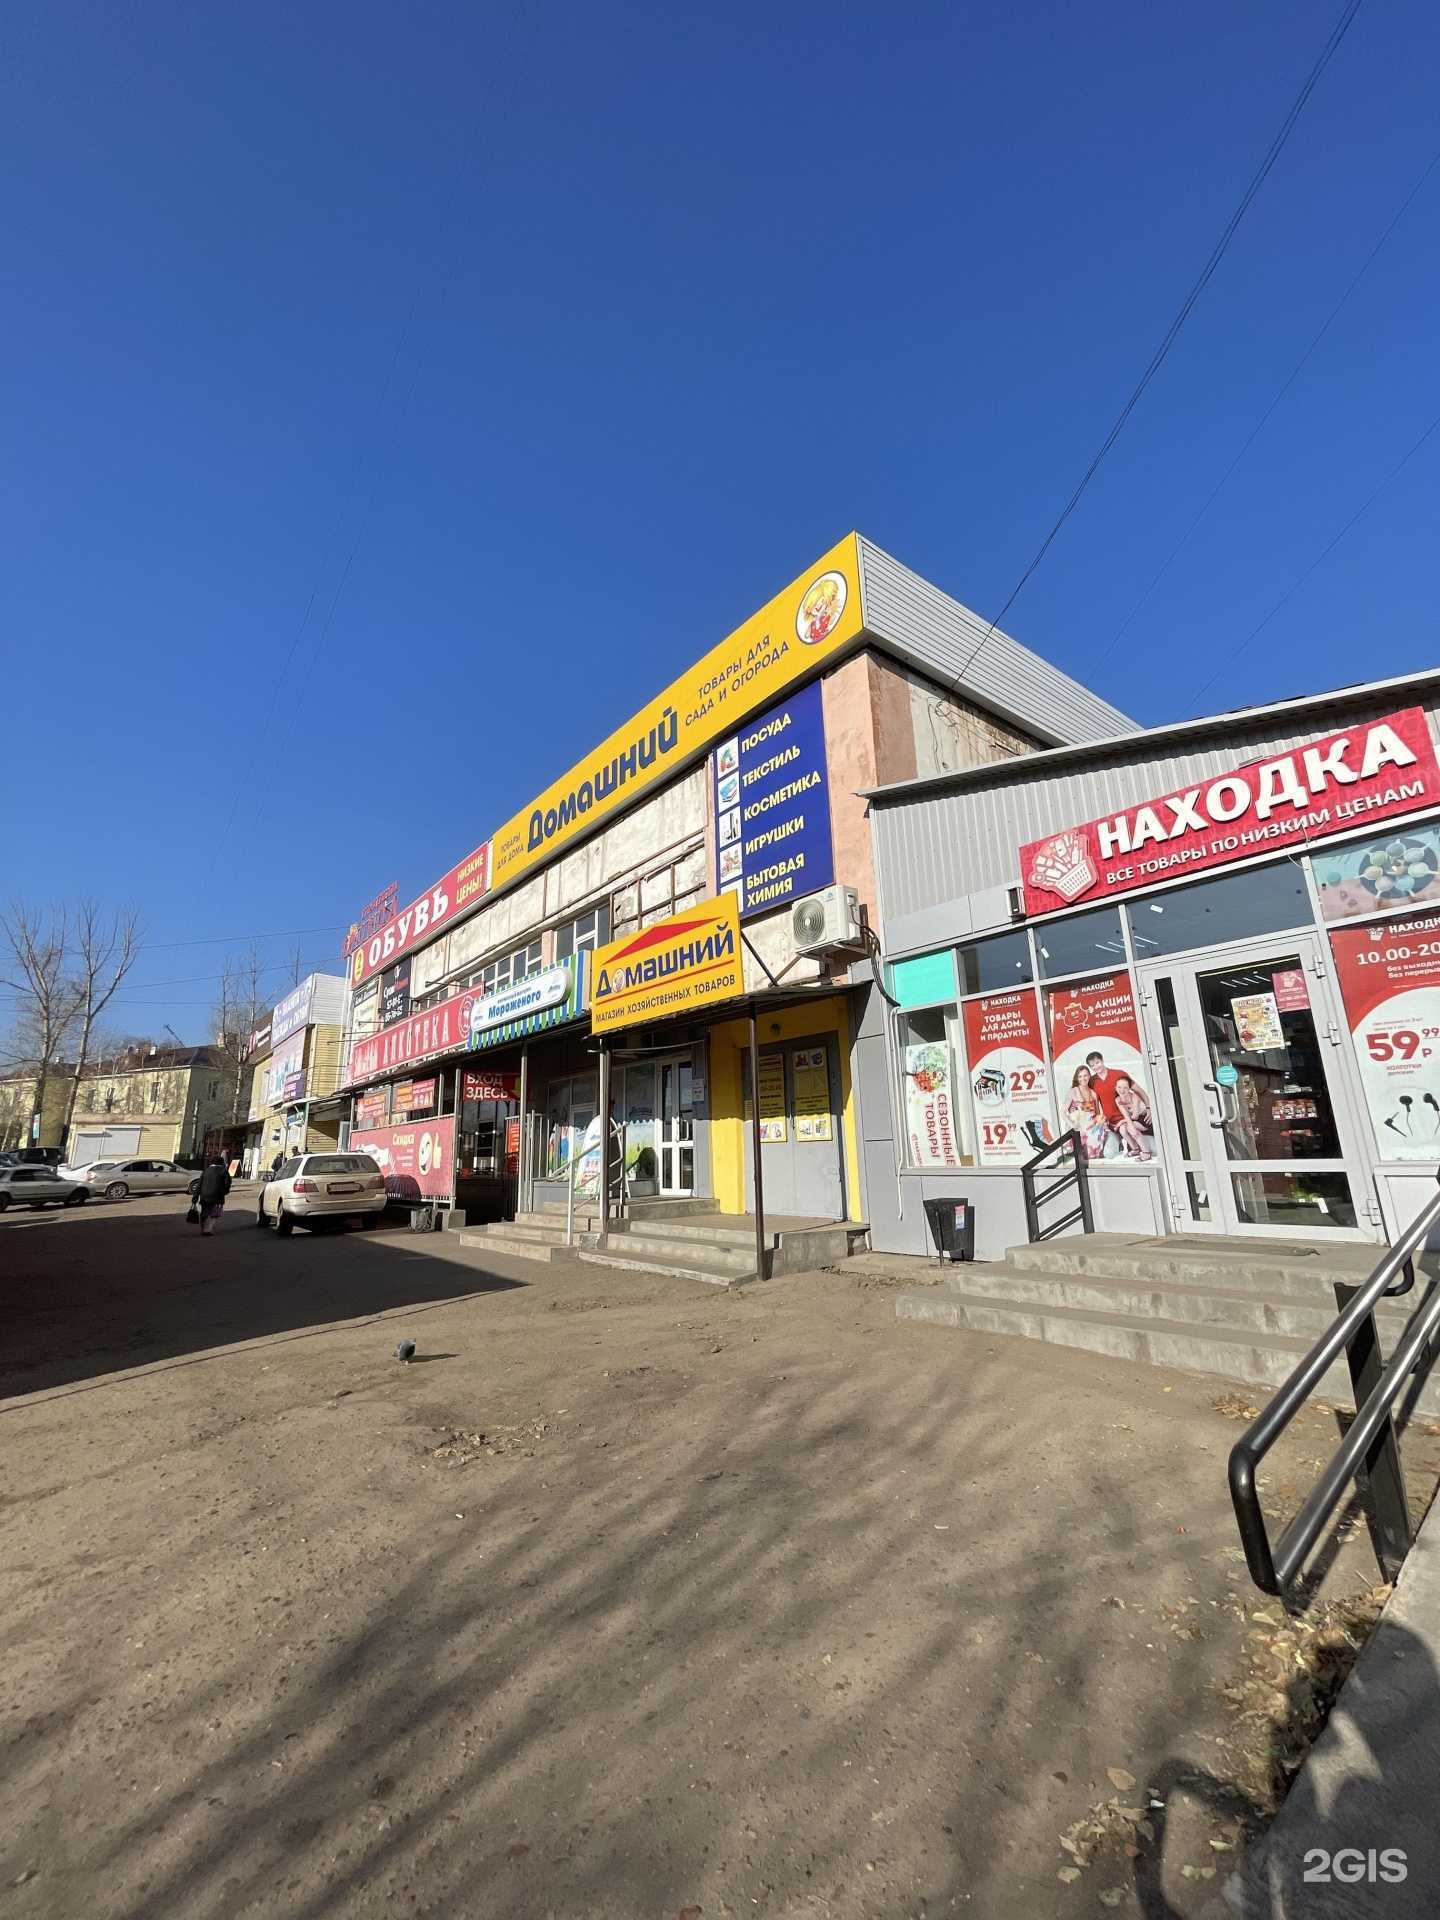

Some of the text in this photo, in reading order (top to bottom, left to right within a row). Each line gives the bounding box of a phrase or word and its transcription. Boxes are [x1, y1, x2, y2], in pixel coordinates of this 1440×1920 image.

[685, 640, 790, 727] САДА И ОГОРОДА
[698, 634, 771, 700] ТОВАРЫ ДЛЯ
[741, 712, 792, 754] ПОСУДА
[527, 706, 678, 853] Домашний
[742, 745, 801, 787] ТЕКСТИЛЬ
[744, 770, 821, 821] КОСМЕТИКА
[1098, 723, 1418, 860] НАХОДКА
[745, 815, 804, 855] ИГРУШКИ
[1106, 780, 1425, 885] ВСЕ ТОВАРЫ ПО НИЗКИМ ЦЕНАМ
[457, 854, 484, 883] НИЗКИЕ
[746, 853, 805, 890] БЫТОВАЯ
[456, 872, 483, 905] ЦЕНЫ!
[747, 877, 793, 908] ХИМИЯ
[368, 886, 449, 967] ОБУВЬ
[595, 974, 736, 1023] МАГАЗИН ХОЗЯЙСТВЕННЫХ ТОВАРОВ
[990, 995, 1022, 1006] НАХОДКА
[1081, 979, 1115, 993] НАХОДКА
[1094, 994, 1131, 1010] АКЦИИ
[488, 989, 541, 1019] Мороженого
[984, 1010, 1021, 1023] ТОВАРЫ
[1101, 1006, 1133, 1018] СКИДКИ
[383, 1008, 449, 1067] АЛКОТЕКА
[981, 1019, 1026, 1032] ДЛЯ ДОМА
[987, 1028, 1030, 1040] ПРОДУКТЫ
[1366, 1027, 1440, 1062] 59 99
[465, 1086, 509, 1100] ЗДЕСЬ
[466, 1073, 504, 1087] ВХОД
[1009, 1070, 1036, 1091] 29
[924, 1103, 941, 1158] ТОВАРЫ
[937, 1093, 957, 1166] СЕЗОННЫЕ
[983, 1123, 1017, 1145] 19 99
